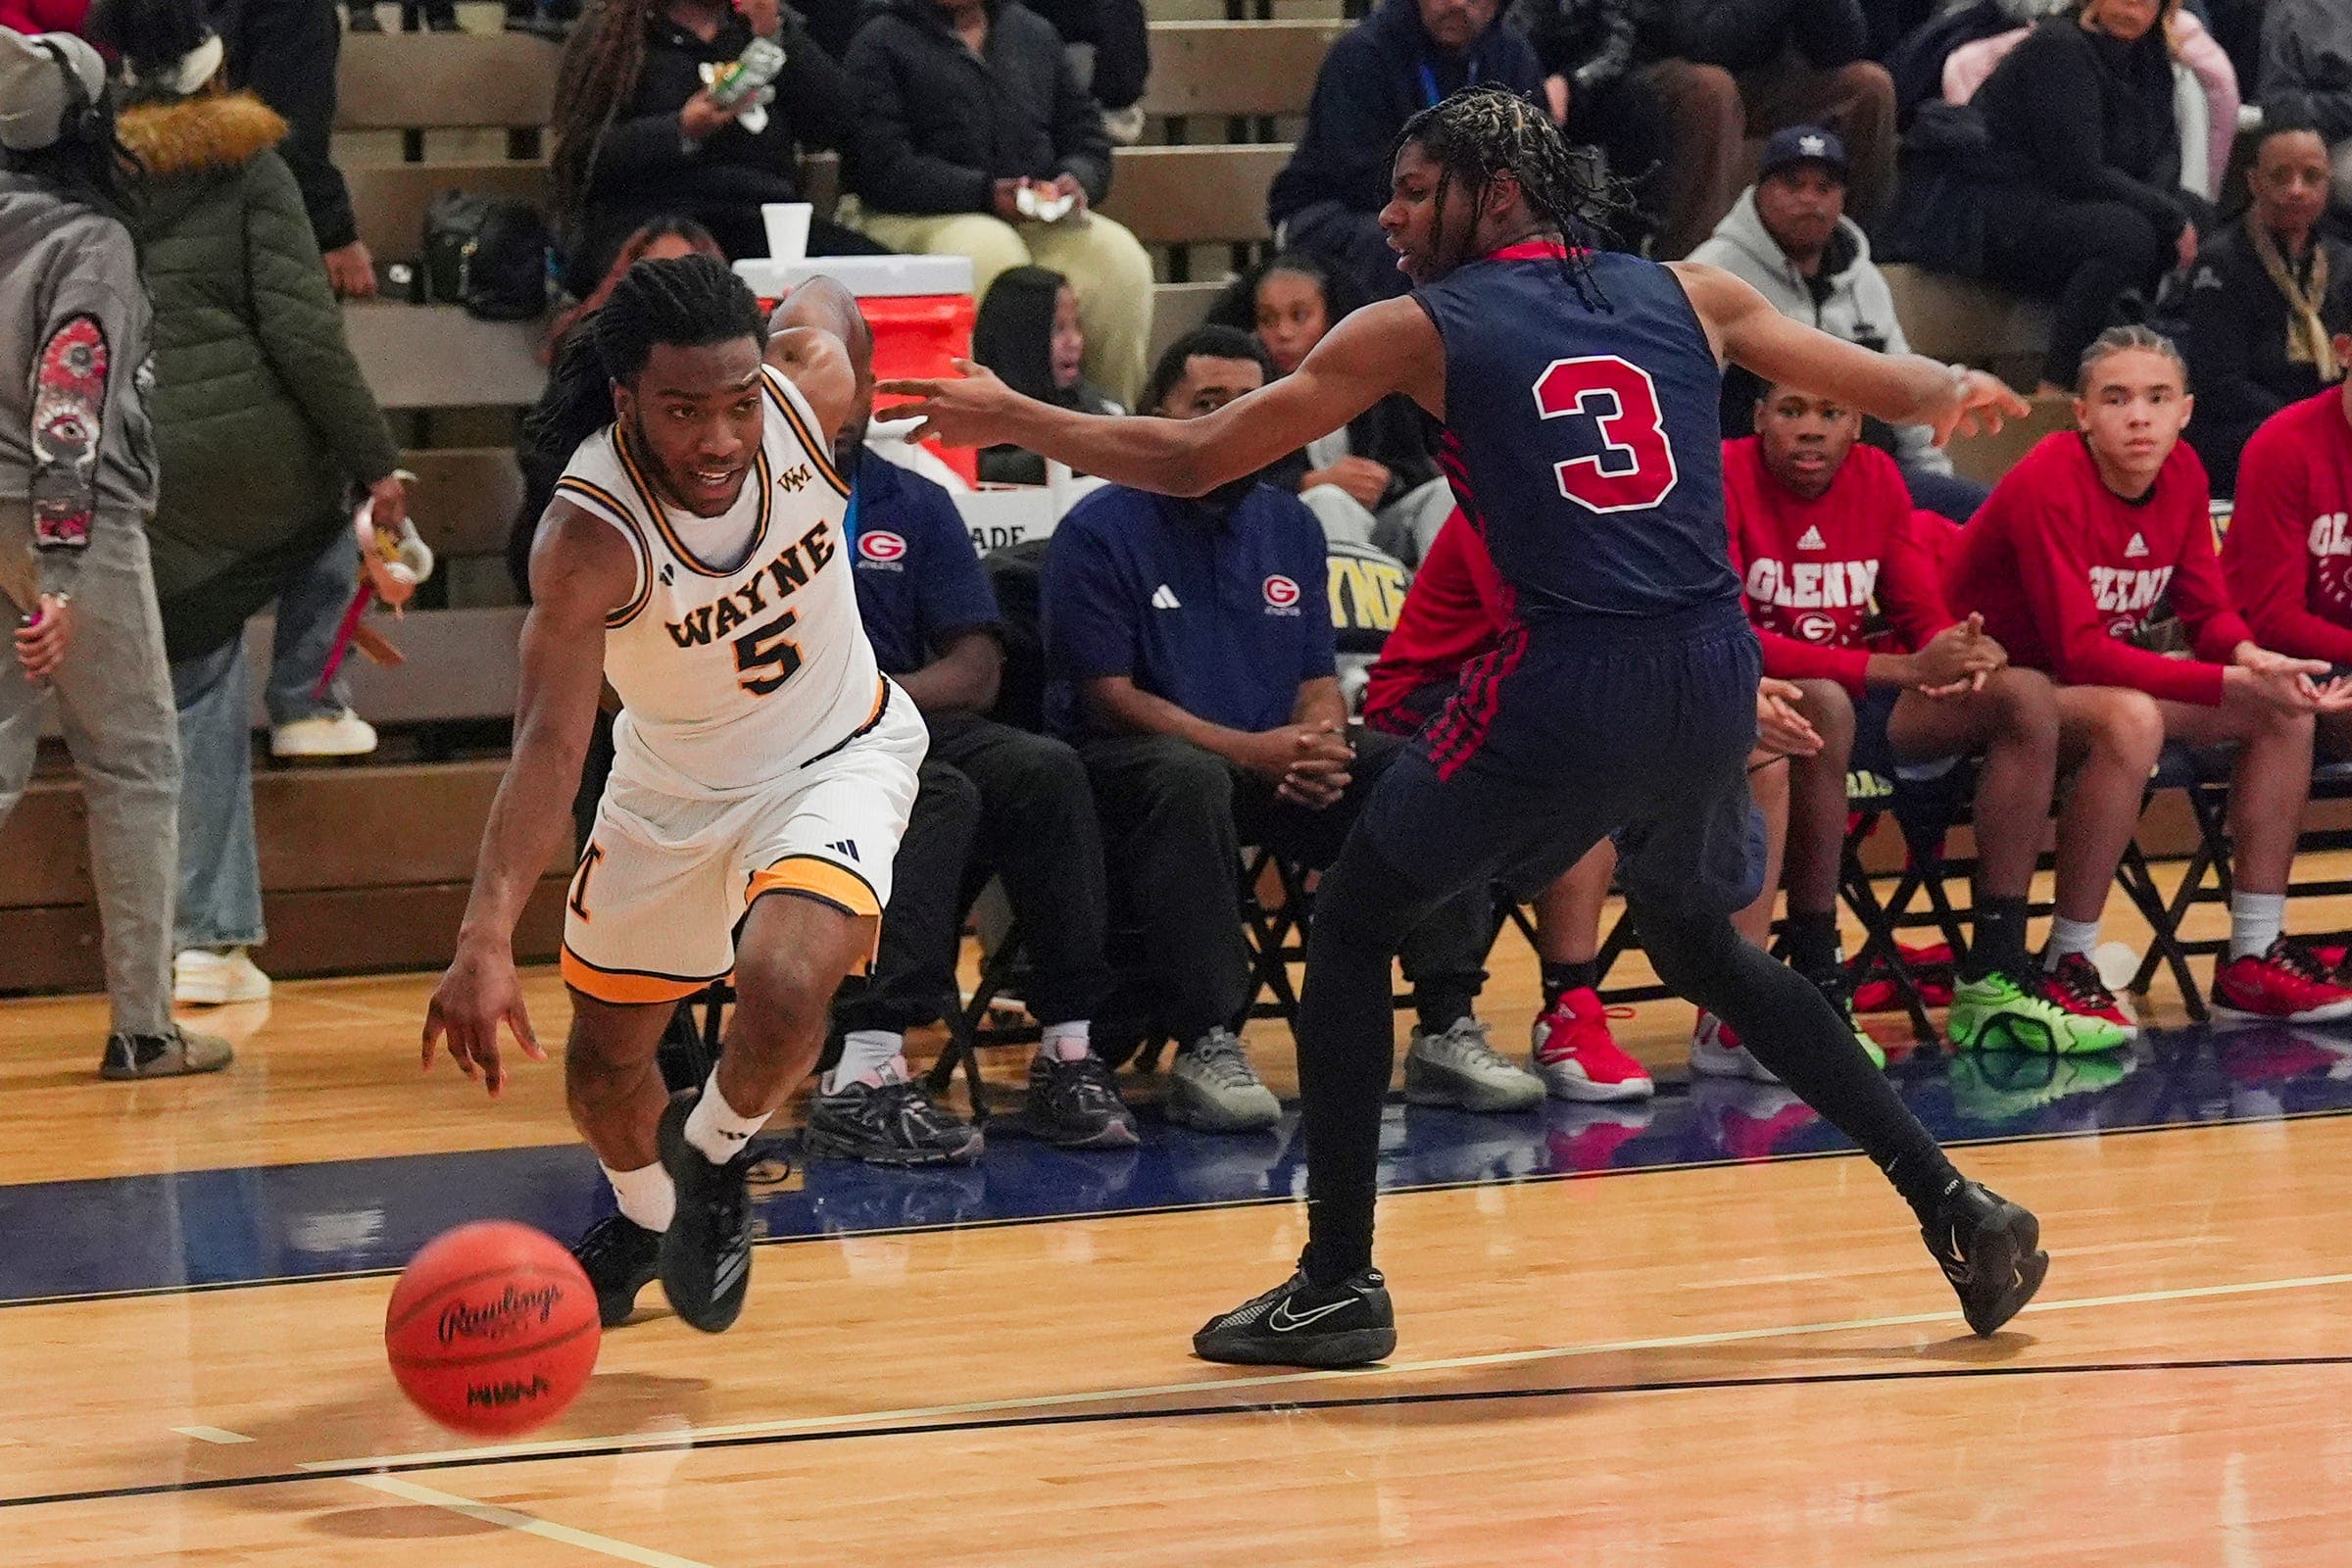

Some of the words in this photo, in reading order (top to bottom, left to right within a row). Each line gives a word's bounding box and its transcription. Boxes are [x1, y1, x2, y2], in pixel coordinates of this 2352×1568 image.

[1532, 355, 1678, 514] 3
[777, 463, 812, 493] WM
[860, 533, 905, 560] G
[664, 518, 835, 648] WAYNE
[1264, 577, 1298, 605] G
[1746, 557, 1880, 609] GLENN
[731, 604, 806, 698] 5
[438, 1284, 563, 1344] Rawlings
